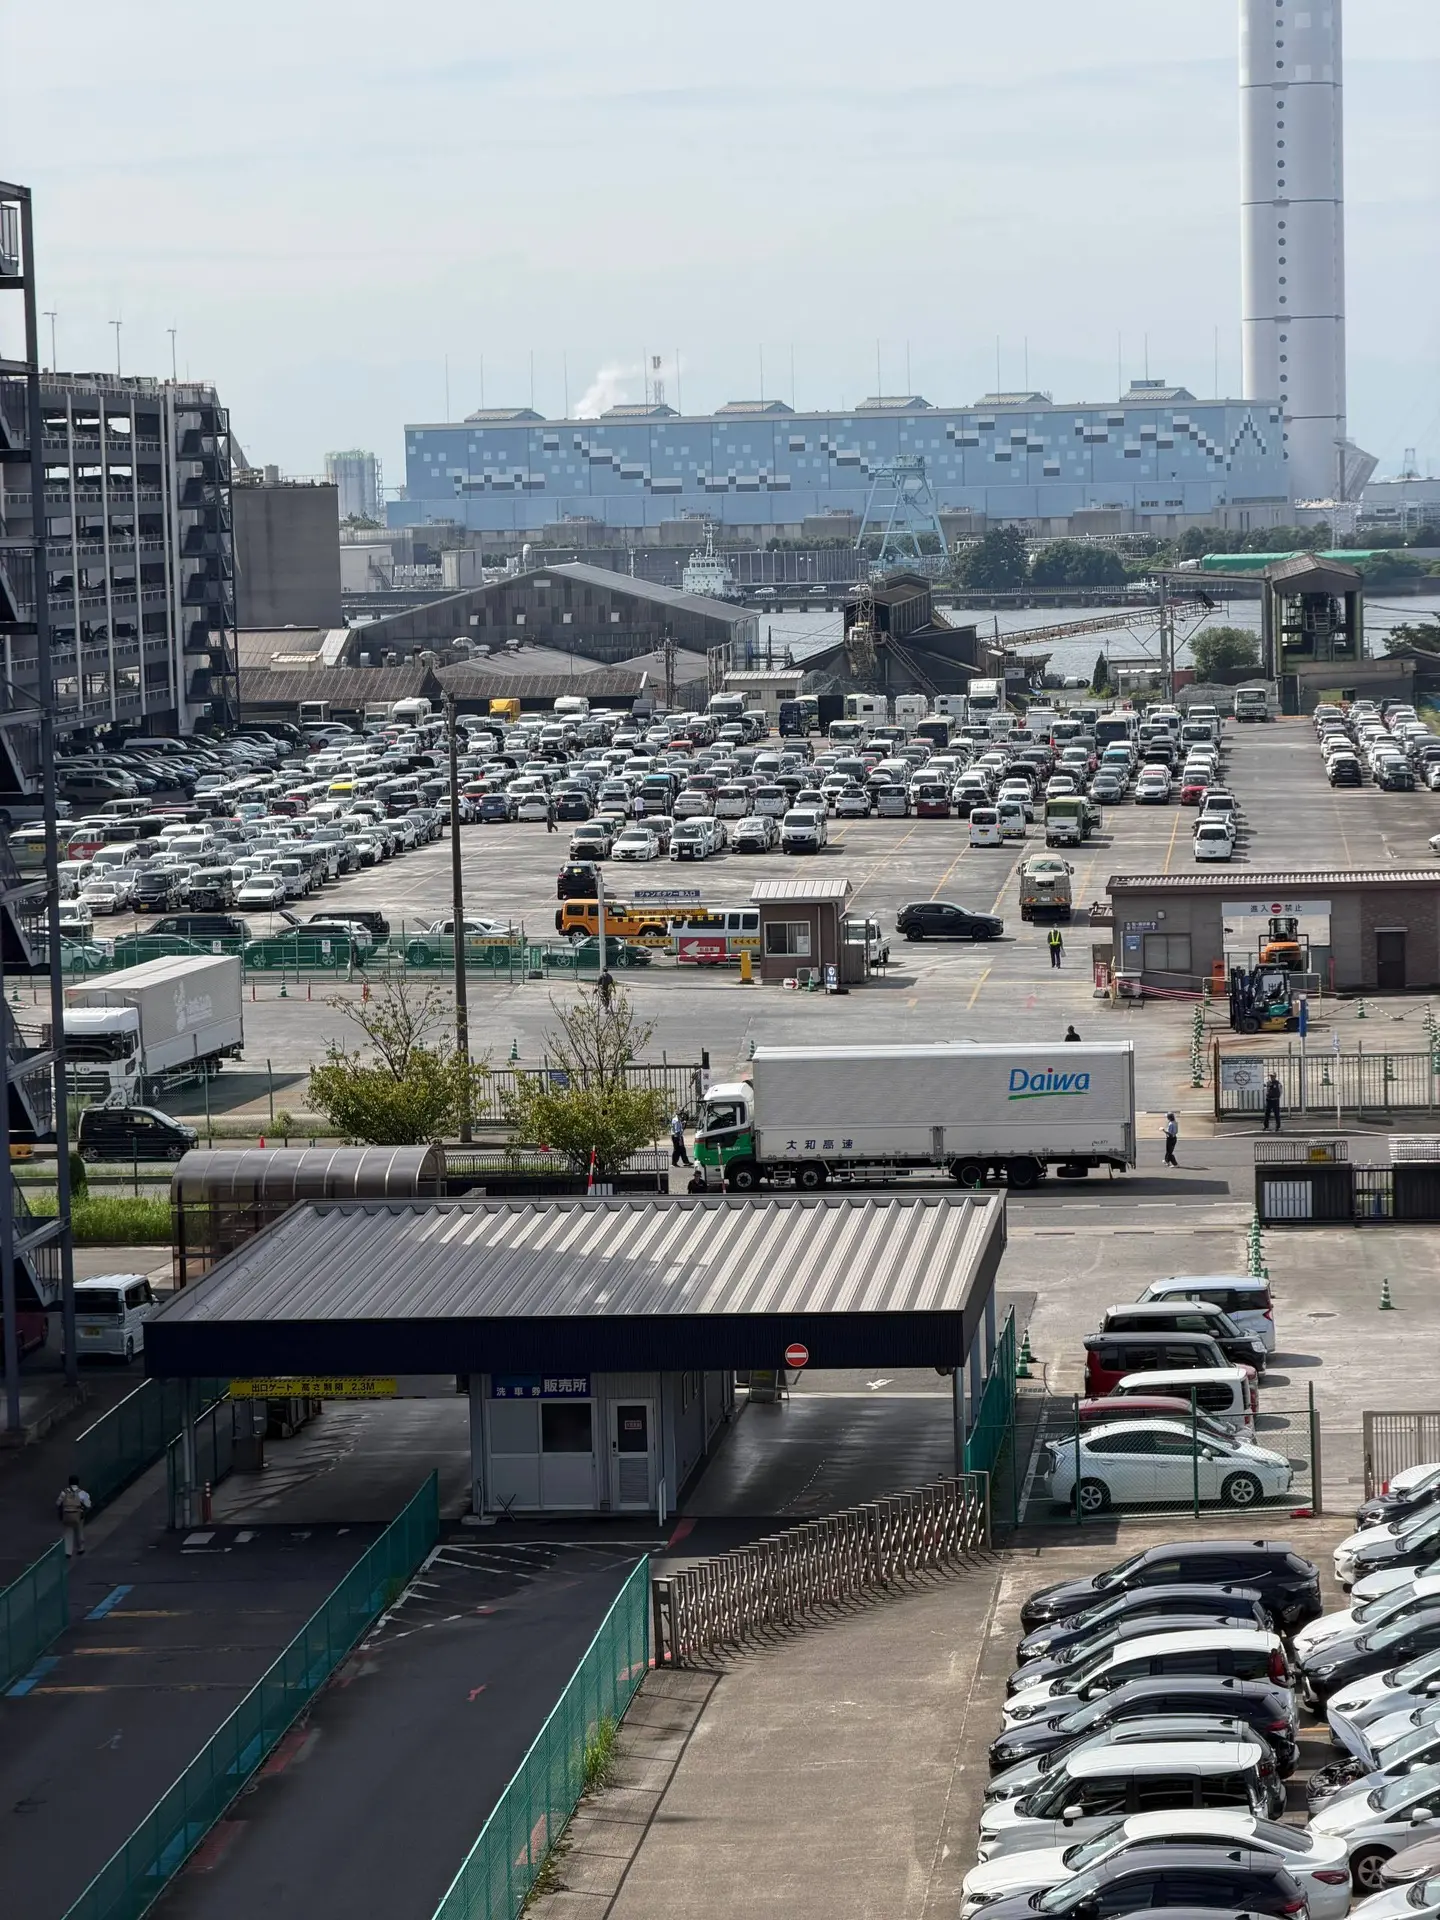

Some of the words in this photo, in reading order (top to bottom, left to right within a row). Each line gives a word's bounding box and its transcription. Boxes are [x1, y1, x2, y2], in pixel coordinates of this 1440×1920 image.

[1250, 904, 1268, 913] 進入
[1285, 904, 1302, 912] 禁止
[1008, 1067, 1090, 1091] Daiwa
[786, 1139, 853, 1150] 大和高速
[251, 1383, 293, 1392] 出口ゲート
[301, 1383, 344, 1392] 高さ制限
[351, 1383, 375, 1391] 2.3M
[496, 1387, 541, 1396] 洗車券
[544, 1378, 587, 1392] 販売所
